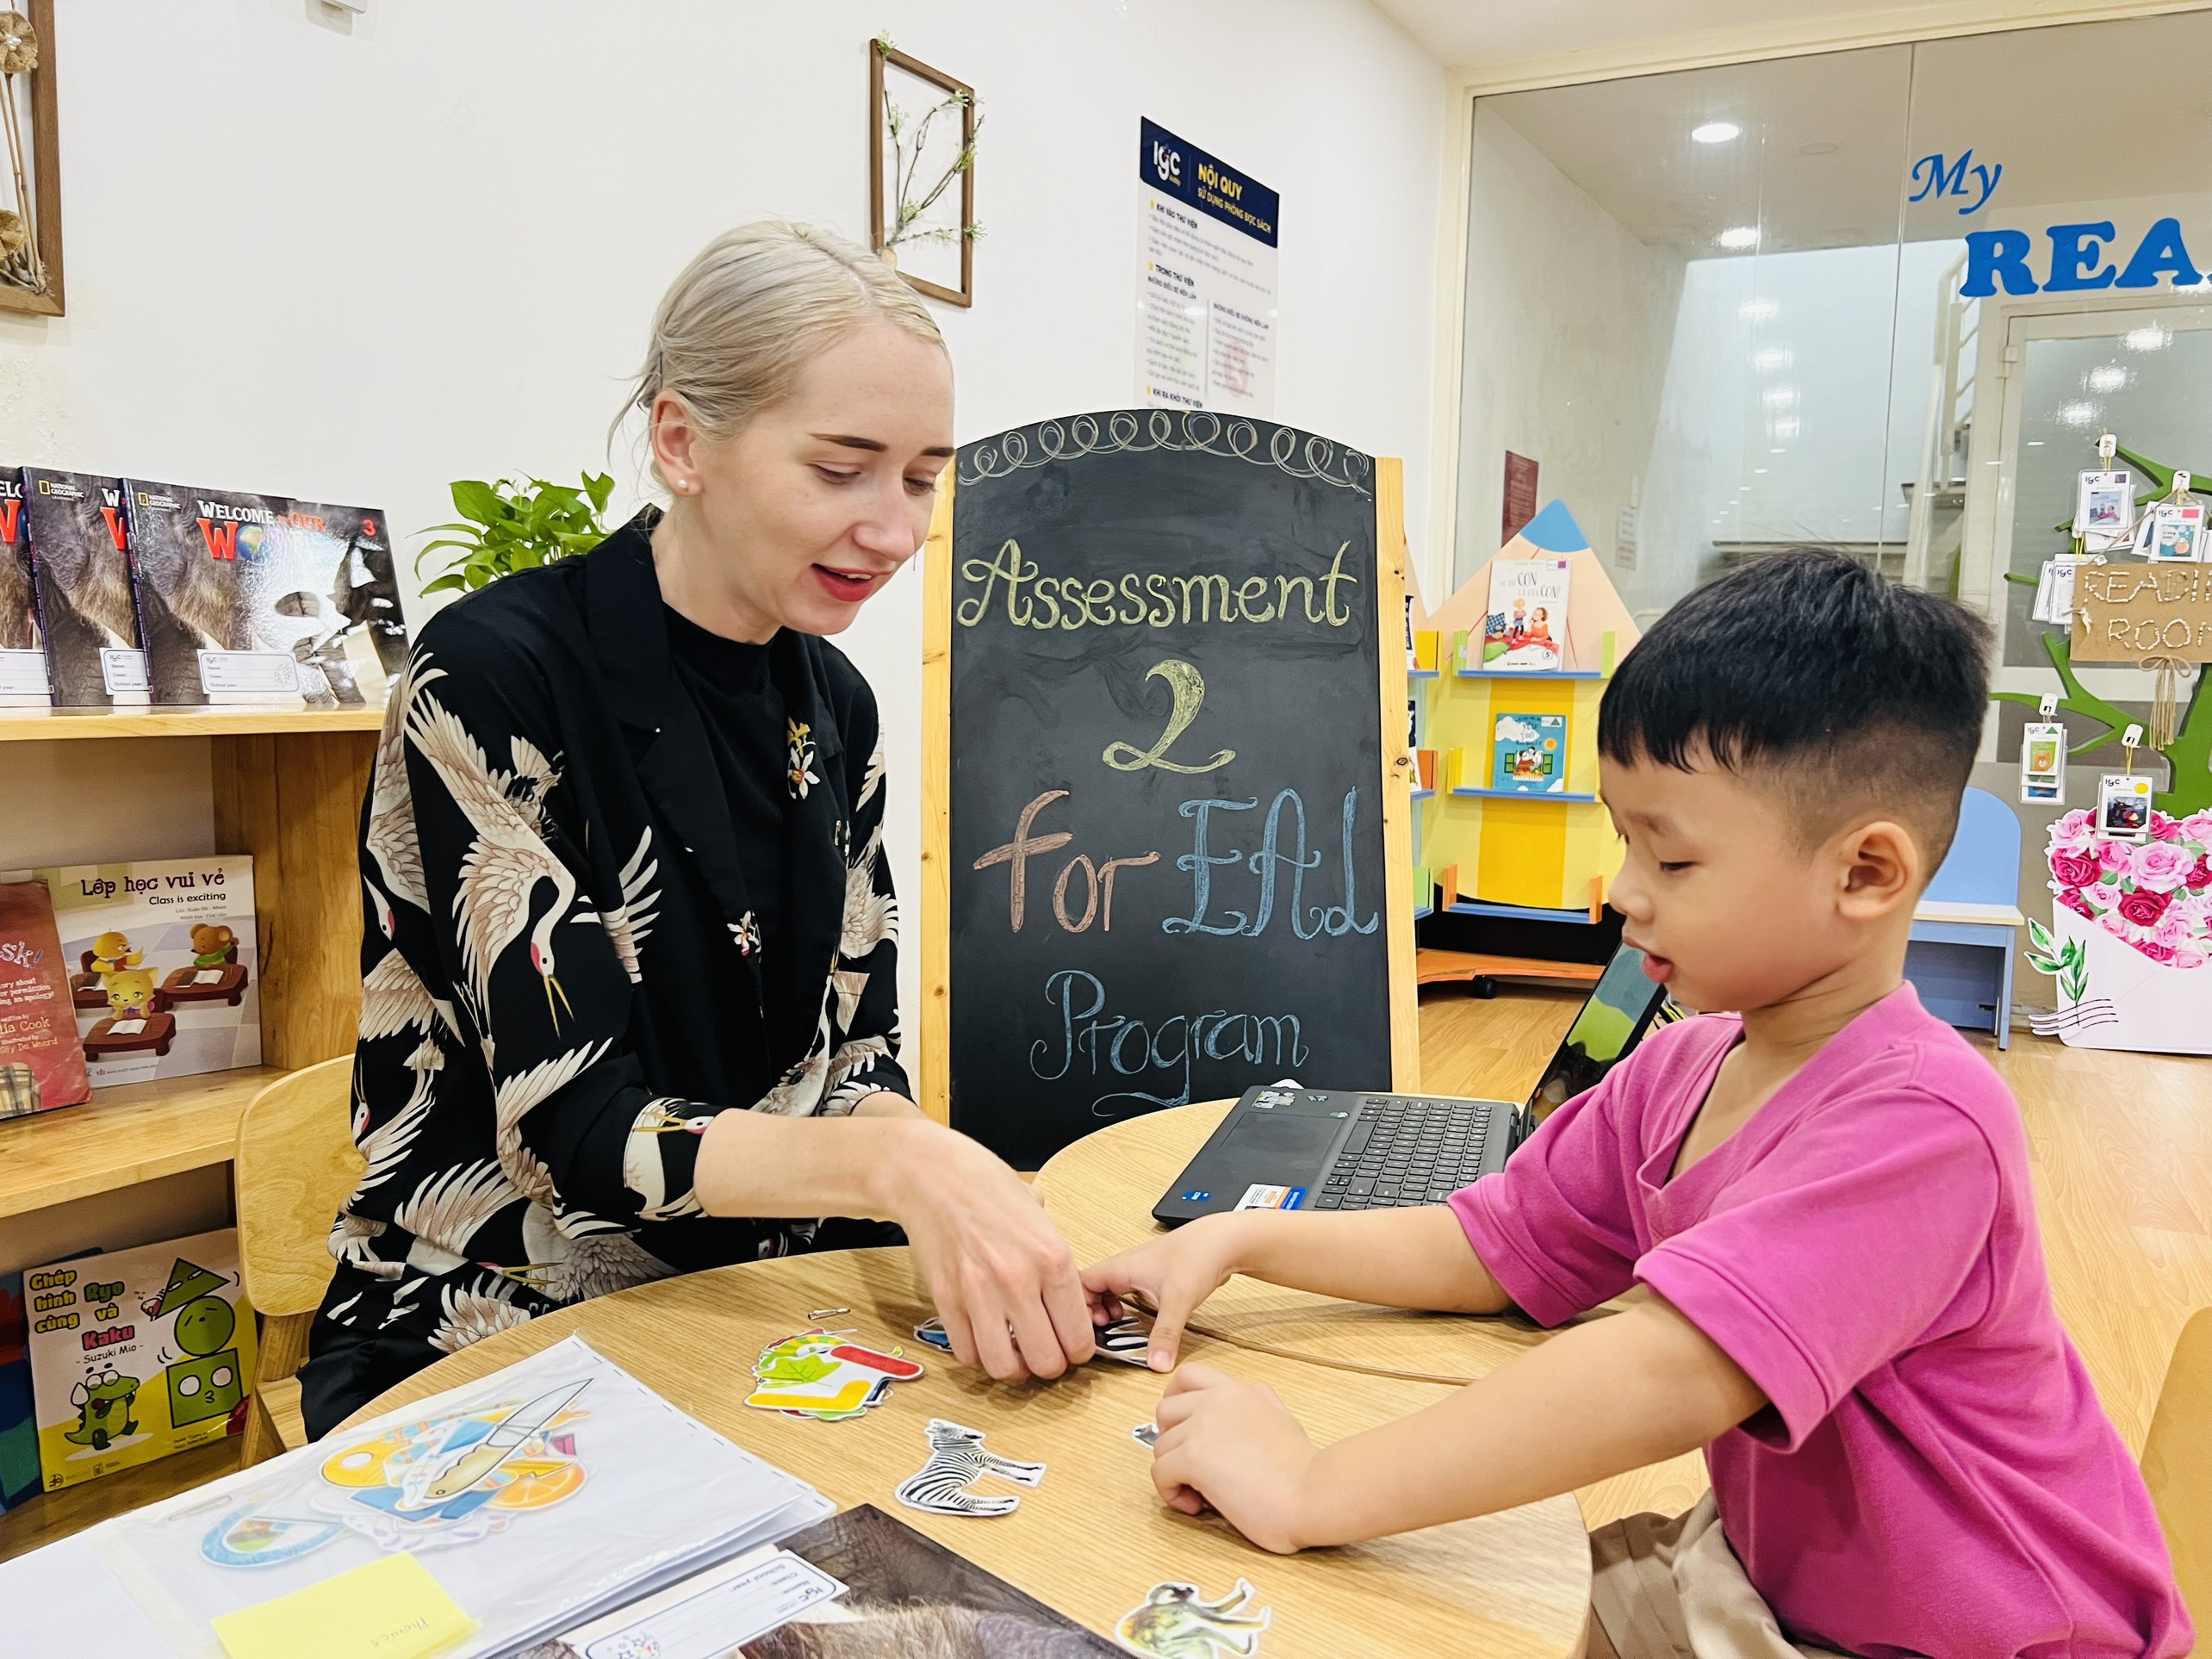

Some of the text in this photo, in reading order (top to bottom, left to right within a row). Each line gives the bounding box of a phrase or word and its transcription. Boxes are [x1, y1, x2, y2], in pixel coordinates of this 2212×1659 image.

[1198, 163, 1218, 190] NỘI
[1220, 176, 1243, 201] QUY
[1909, 148, 2002, 214] My
[1959, 218, 2212, 297] REA
[197, 500, 274, 525] WELCOME
[363, 519, 376, 537] 3
[957, 537, 1358, 631] Assessment
[1102, 658, 1236, 774] 2
[81, 867, 225, 898] Lớp học vui vẻ
[149, 892, 226, 905] Class is exciting
[16, 978, 36, 987] about
[20, 1016, 51, 1031] Cook
[1030, 970, 1309, 1116] Program
[29, 1269, 78, 1290] Ghép
[34, 1290, 76, 1312] hình
[84, 1282, 125, 1302] Ryo
[95, 1302, 119, 1321] và
[34, 1313, 80, 1333] cùng
[82, 1325, 134, 1351] Kaku
[84, 1345, 137, 1364] Suzuki Mio
